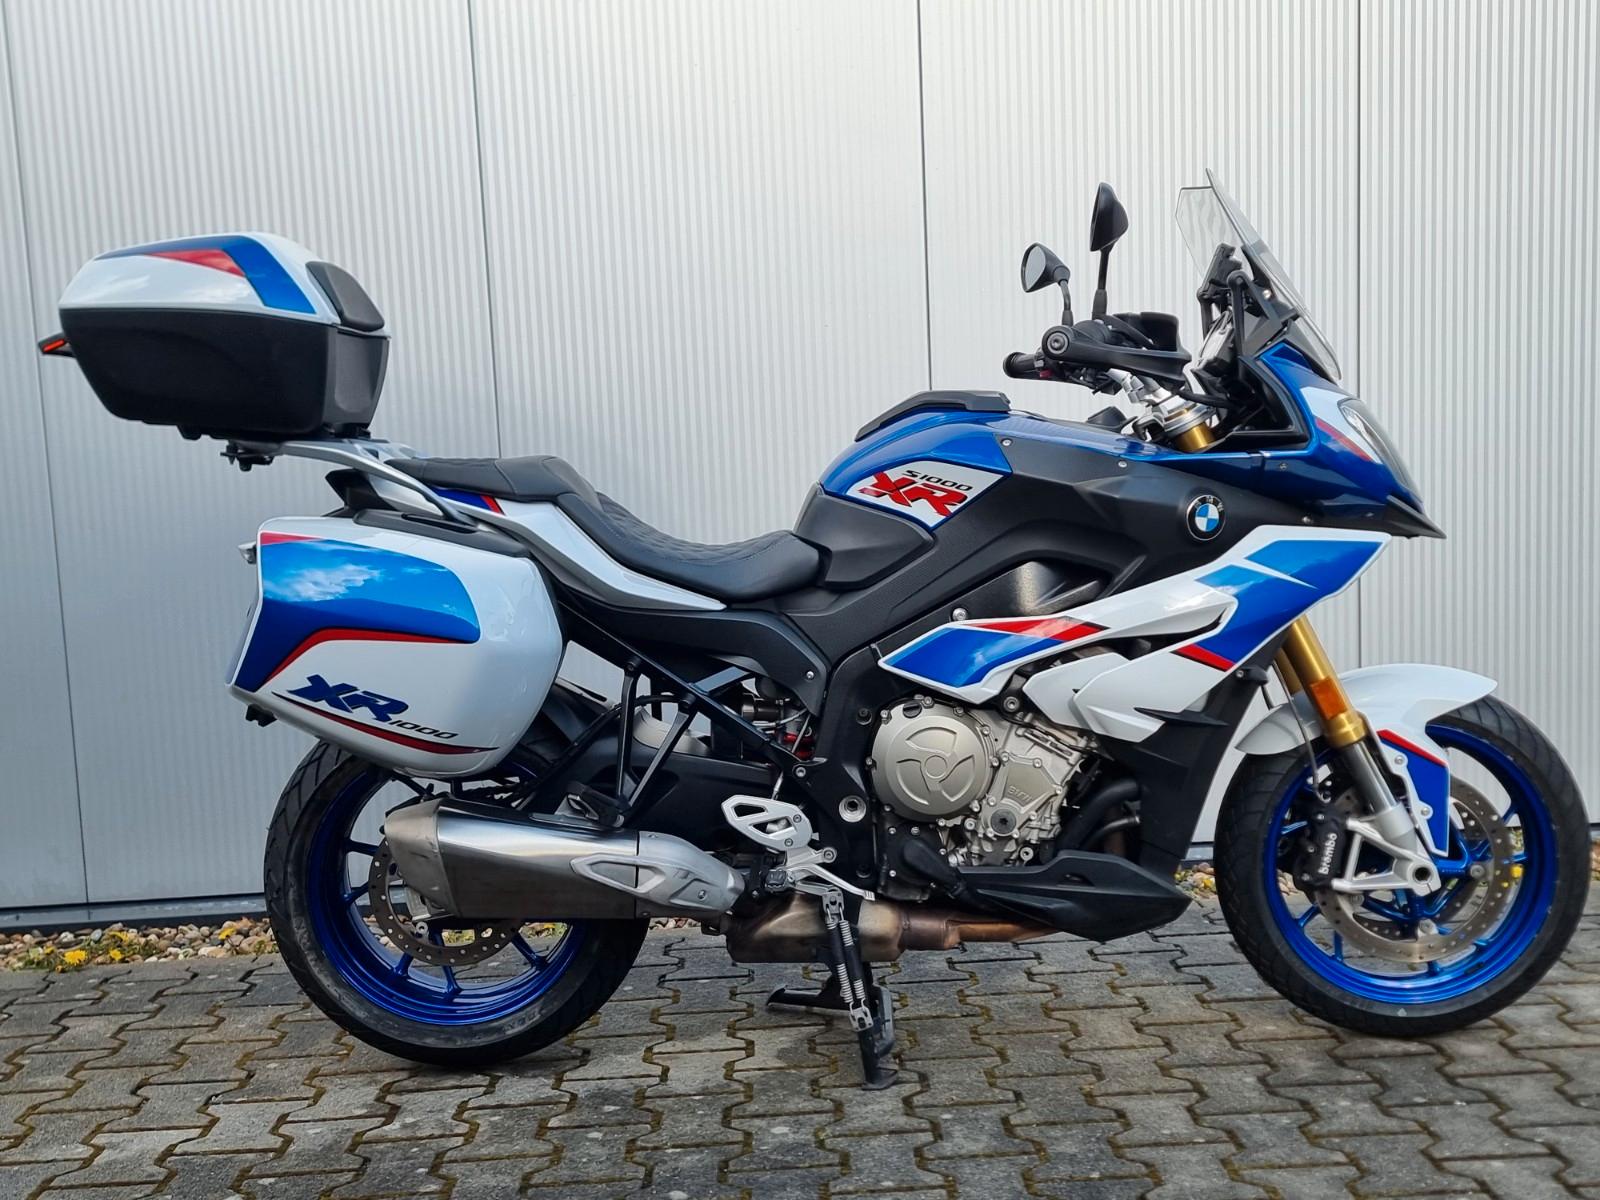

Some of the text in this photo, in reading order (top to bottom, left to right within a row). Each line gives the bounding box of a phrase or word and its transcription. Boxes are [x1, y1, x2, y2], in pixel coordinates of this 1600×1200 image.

[858, 471, 968, 517] XR
[902, 469, 974, 492] S1000
[1194, 495, 1224, 512] BMW
[286, 674, 459, 740] XR 1000
[1317, 833, 1338, 875] brembo
